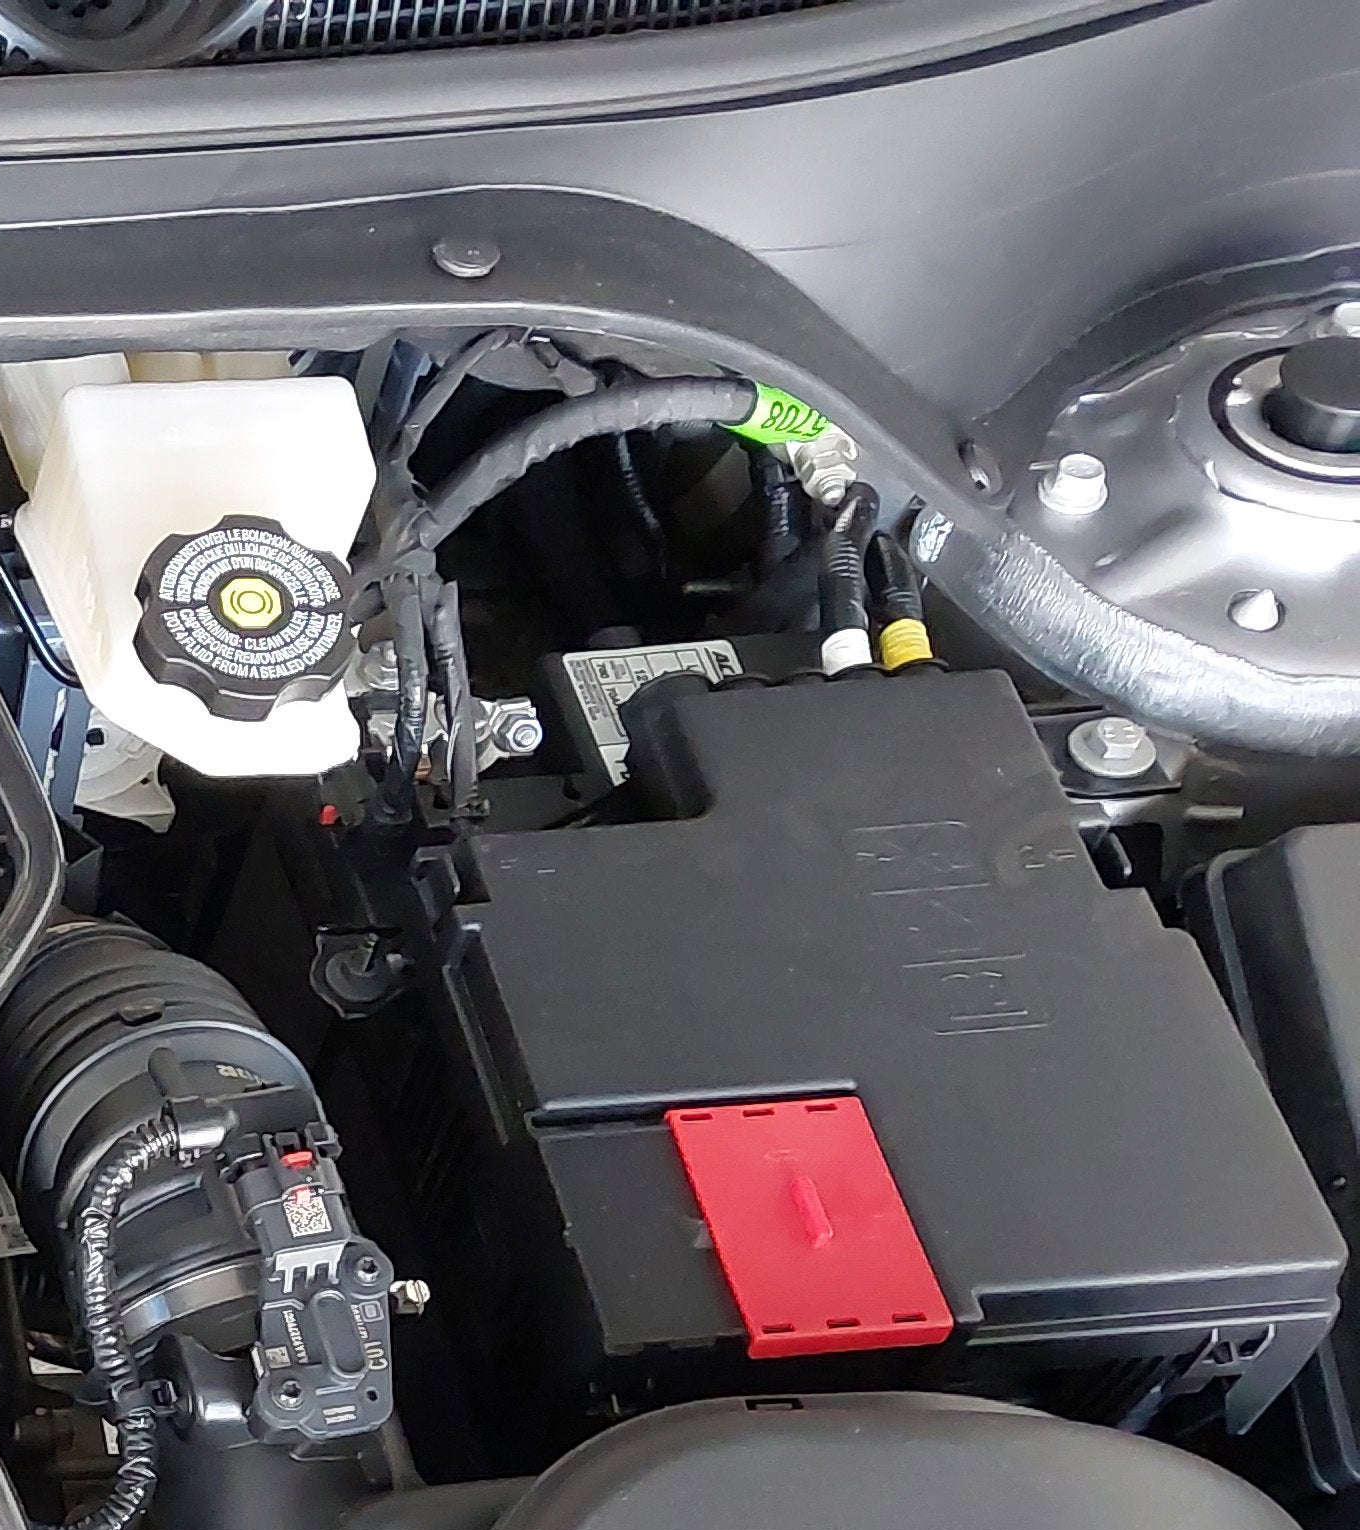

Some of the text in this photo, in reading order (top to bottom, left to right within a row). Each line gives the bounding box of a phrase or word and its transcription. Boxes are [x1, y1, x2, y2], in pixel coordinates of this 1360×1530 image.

[227, 529, 241, 541] LE
[275, 552, 293, 567] DE
[304, 582, 323, 599] DOT
[161, 611, 185, 634] DOT
[183, 637, 213, 664] FLUID
[212, 657, 248, 678] FROM
[249, 666, 260, 678] A
[260, 659, 305, 679] SEALED
[180, 609, 201, 628] CAP
[192, 627, 235, 659] BEFORE
[290, 634, 314, 653] USE
[305, 612, 325, 638] ONLY
[196, 606, 310, 650] WARNING: CLEAN FILLER
